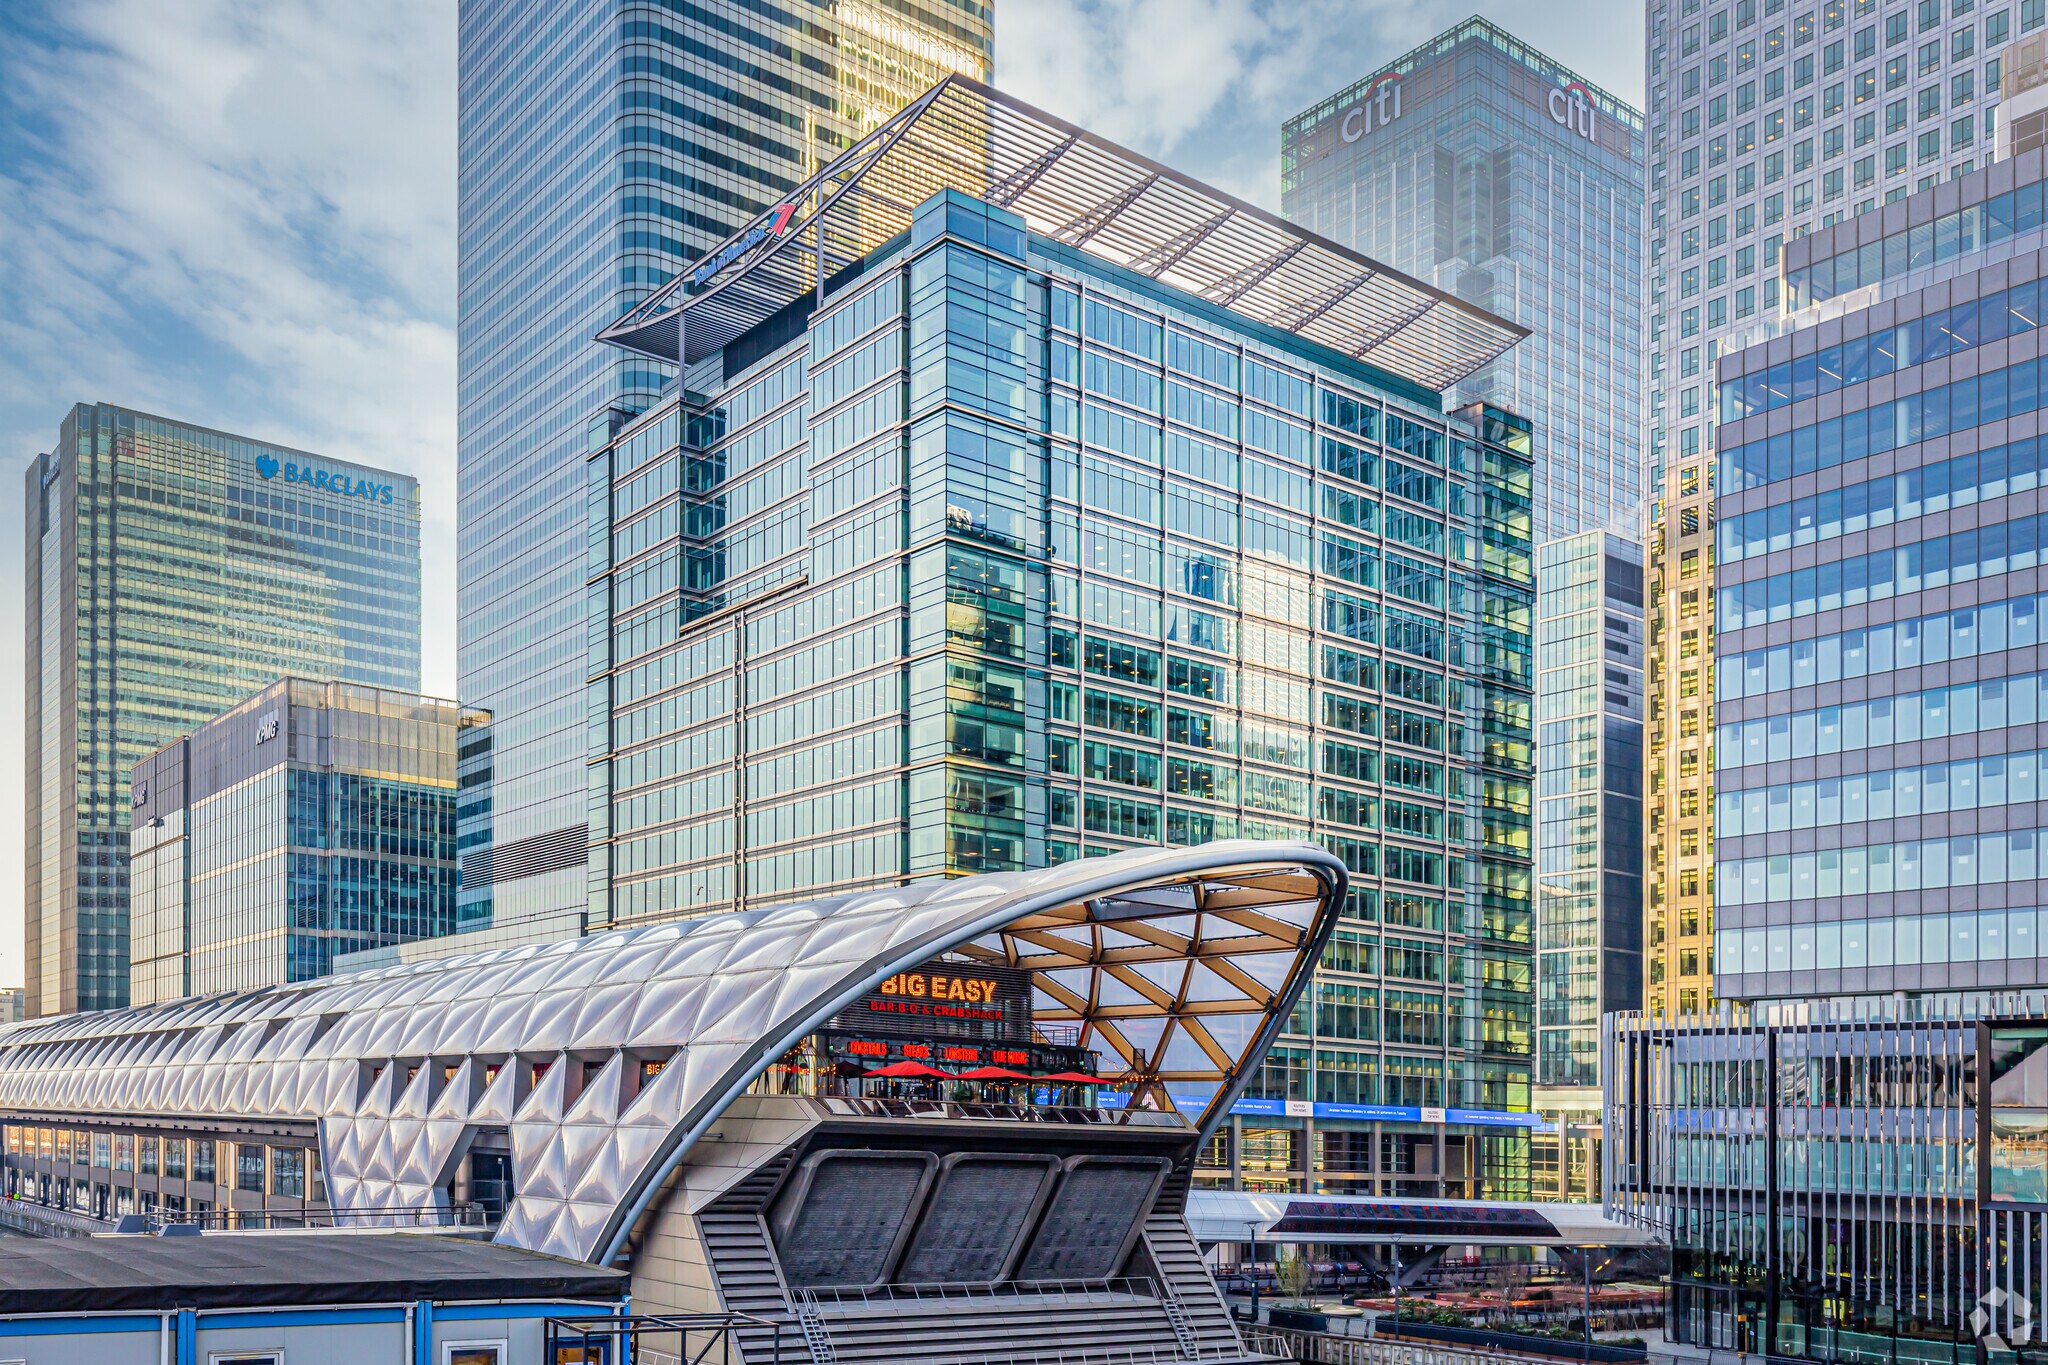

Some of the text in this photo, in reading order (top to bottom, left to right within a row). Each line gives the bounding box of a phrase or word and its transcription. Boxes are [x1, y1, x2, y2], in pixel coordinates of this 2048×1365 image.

[1341, 84, 1401, 143] citi
[1548, 88, 1595, 142] citi
[284, 462, 393, 504] BARCLAYS
[256, 720, 276, 745] KPMG
[881, 973, 997, 1003] BIG EASY
[921, 1005, 930, 1015] &
[246, 1157, 264, 1171] PUD
